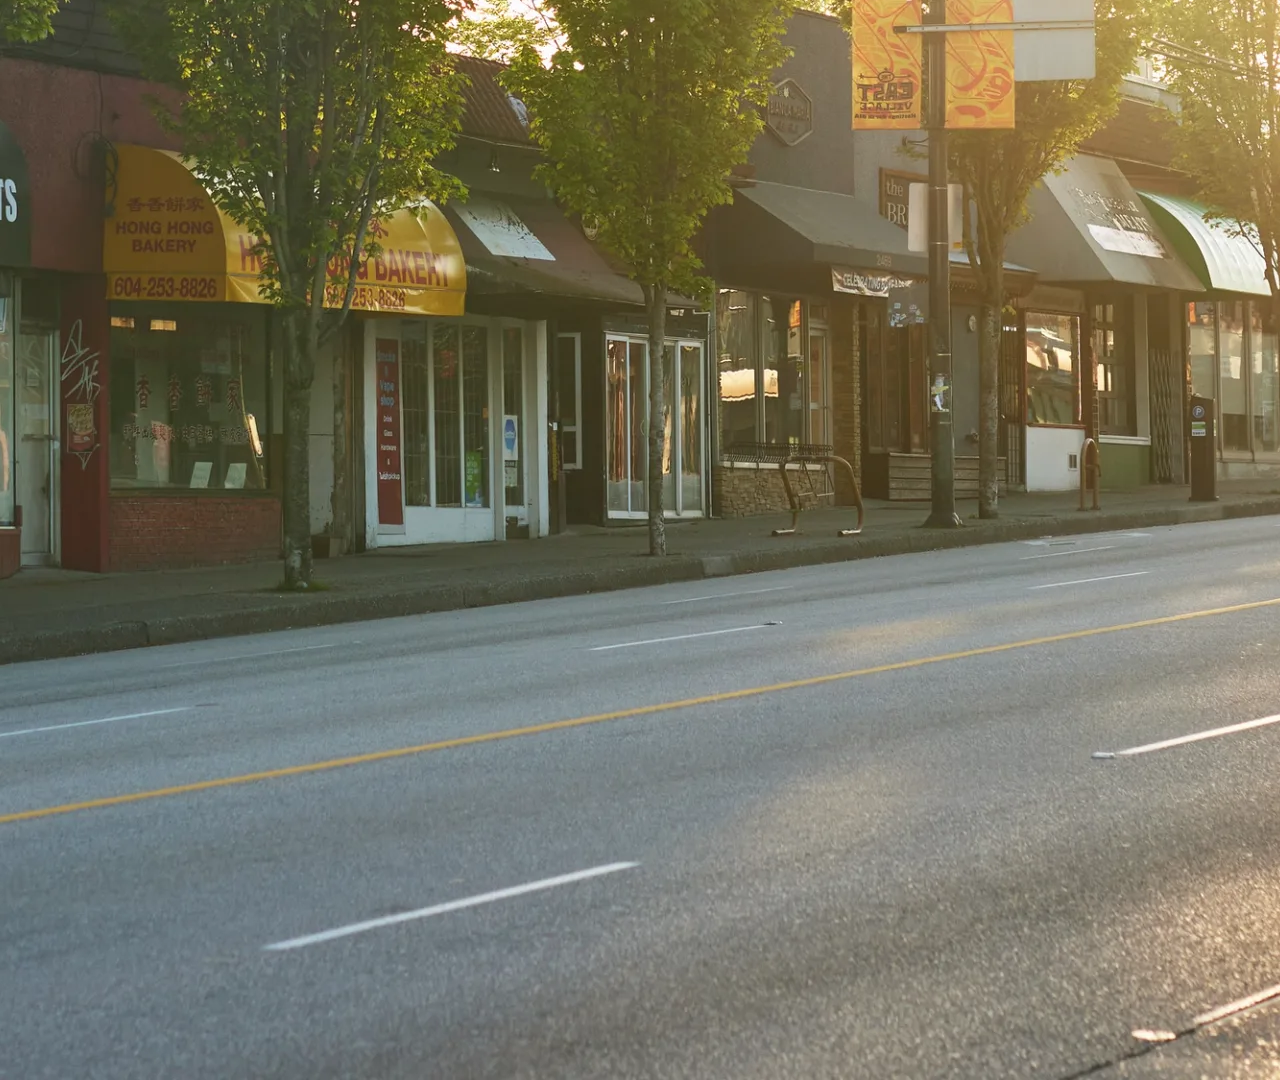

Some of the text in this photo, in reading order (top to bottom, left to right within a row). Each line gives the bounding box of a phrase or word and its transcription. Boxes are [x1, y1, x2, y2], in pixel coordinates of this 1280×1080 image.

[886, 179, 903, 197] the
[115, 221, 214, 235] HONG HONG
[132, 239, 196, 253] BAKERY
[375, 248, 450, 287] BAKERY
[114, 277, 217, 298] 604-253-8826
[843, 273, 880, 289] CELEBRATING
